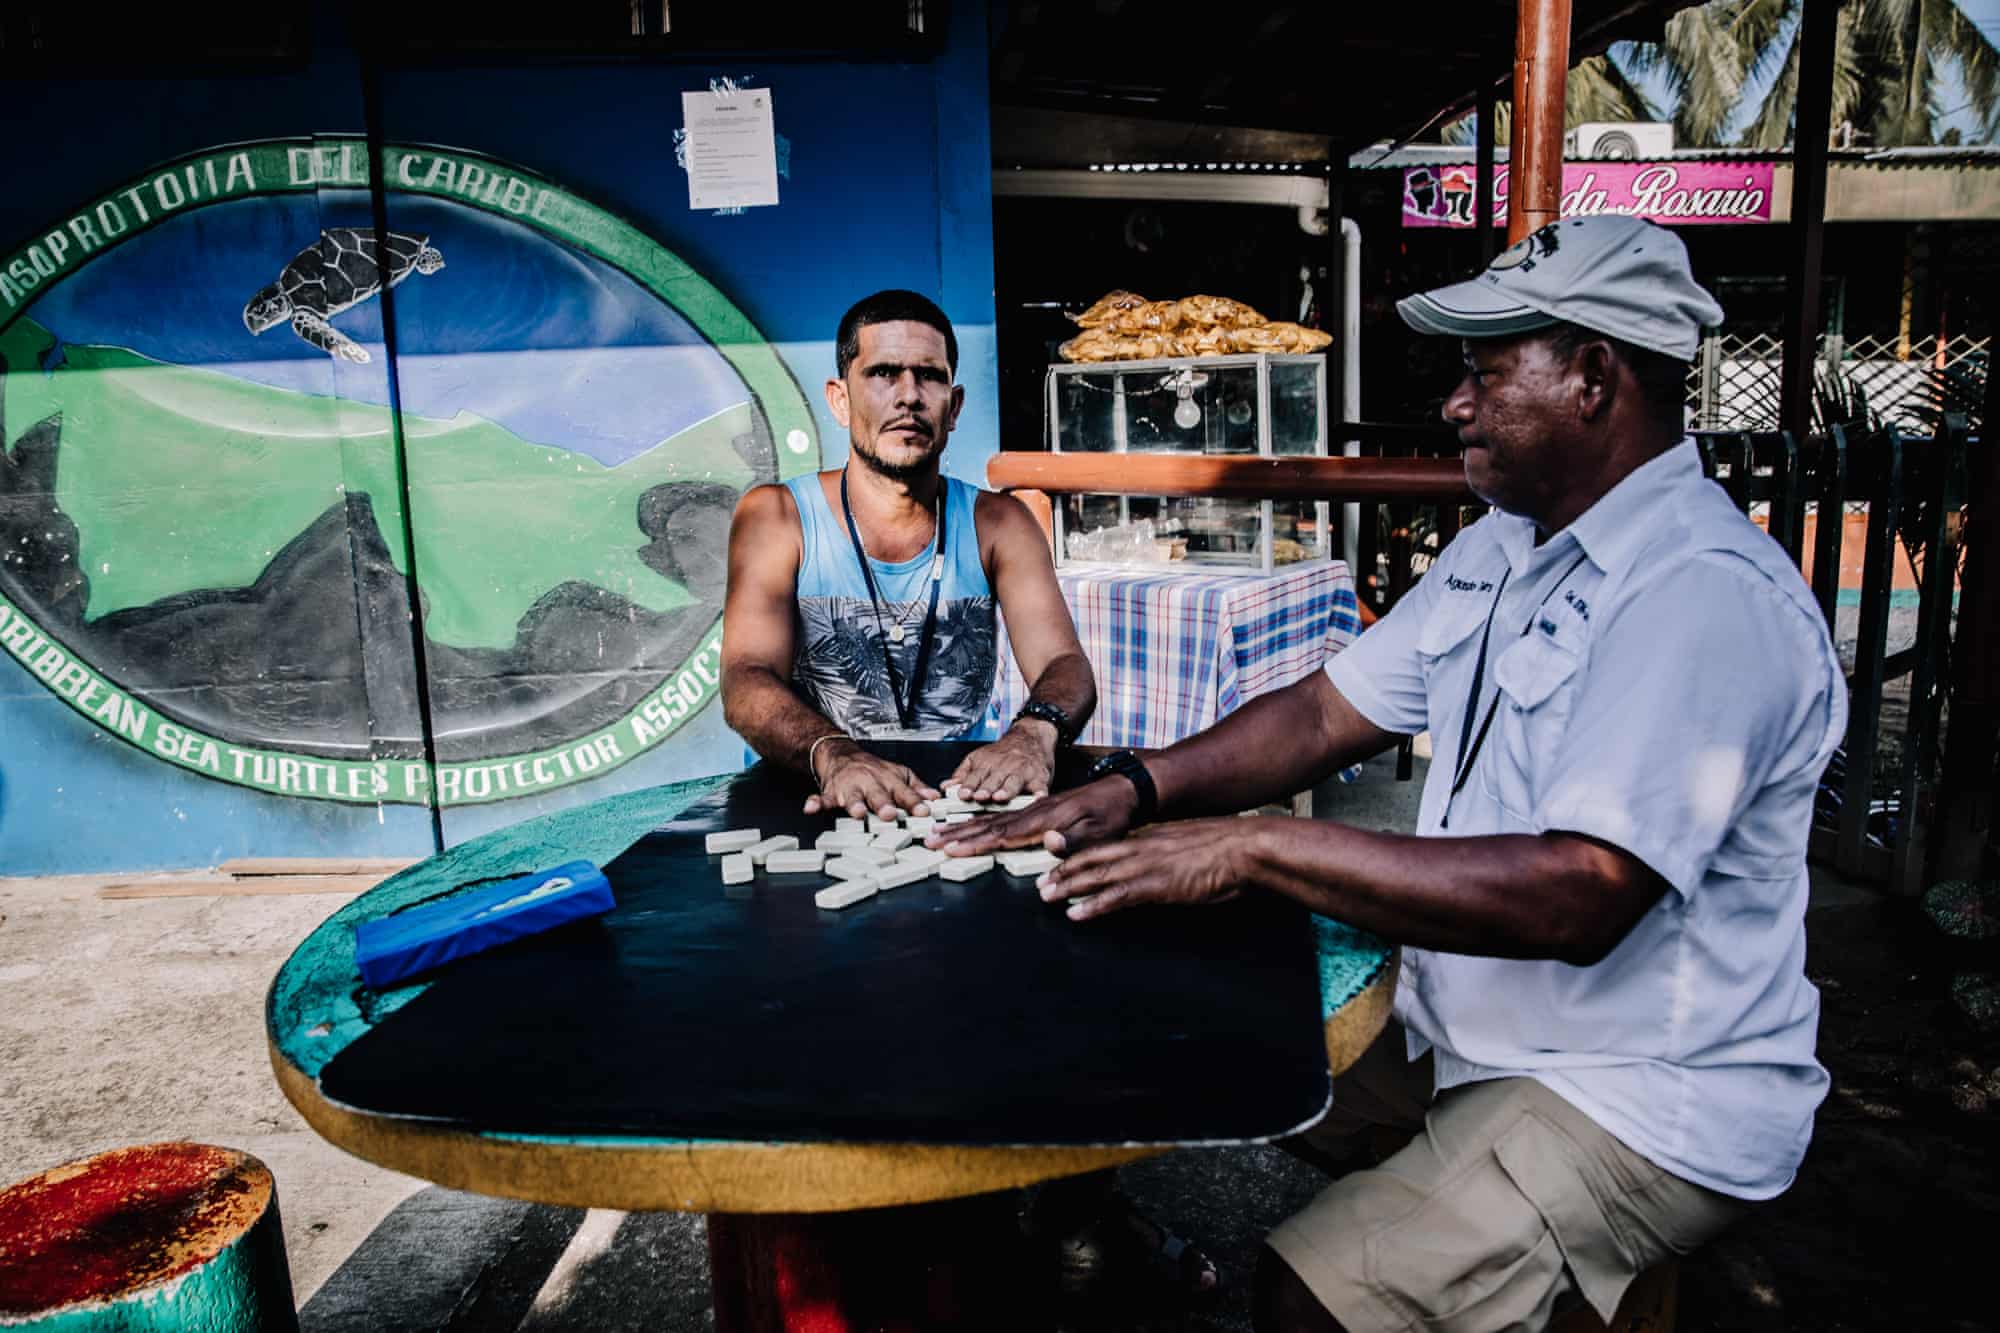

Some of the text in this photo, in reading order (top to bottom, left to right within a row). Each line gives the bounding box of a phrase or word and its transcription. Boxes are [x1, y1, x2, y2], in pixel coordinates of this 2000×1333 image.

[287, 145, 366, 186] DEL
[399, 153, 558, 224] CARIBE
[1618, 167, 1764, 216] Rosario
[155, 723, 220, 772] SEA
[229, 749, 389, 798] TURTLES
[405, 733, 622, 802] PROTECTOR
